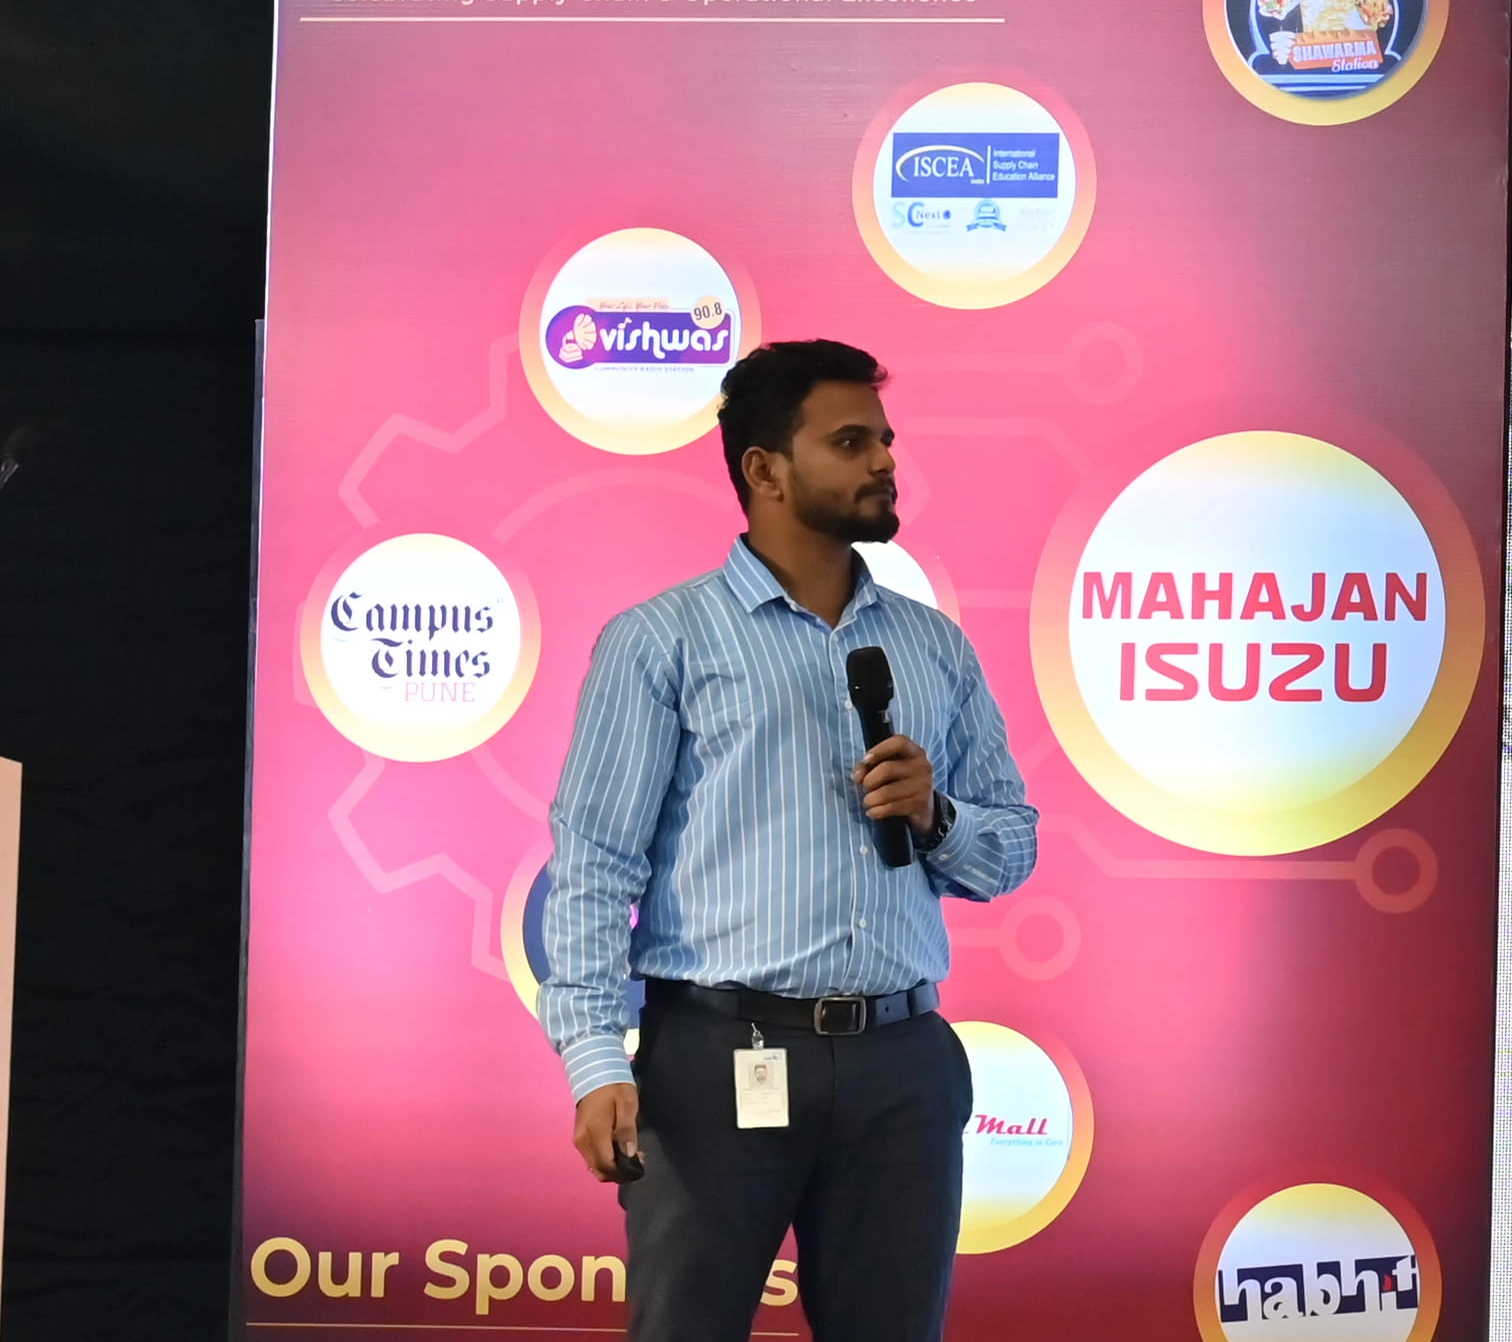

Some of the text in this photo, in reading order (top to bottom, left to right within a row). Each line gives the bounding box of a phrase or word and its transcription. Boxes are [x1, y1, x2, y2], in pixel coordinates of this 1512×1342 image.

[914, 156, 974, 177] ISCEA
[693, 301, 722, 321] 90.8
[331, 592, 493, 641] Campus
[1081, 571, 1428, 622] MAHAJAN
[371, 638, 490, 678] Times
[1120, 643, 1387, 702] ISUZU
[405, 682, 475, 702] PUNE
[975, 1114, 1047, 1135] Mall
[250, 1237, 399, 1297] Our
